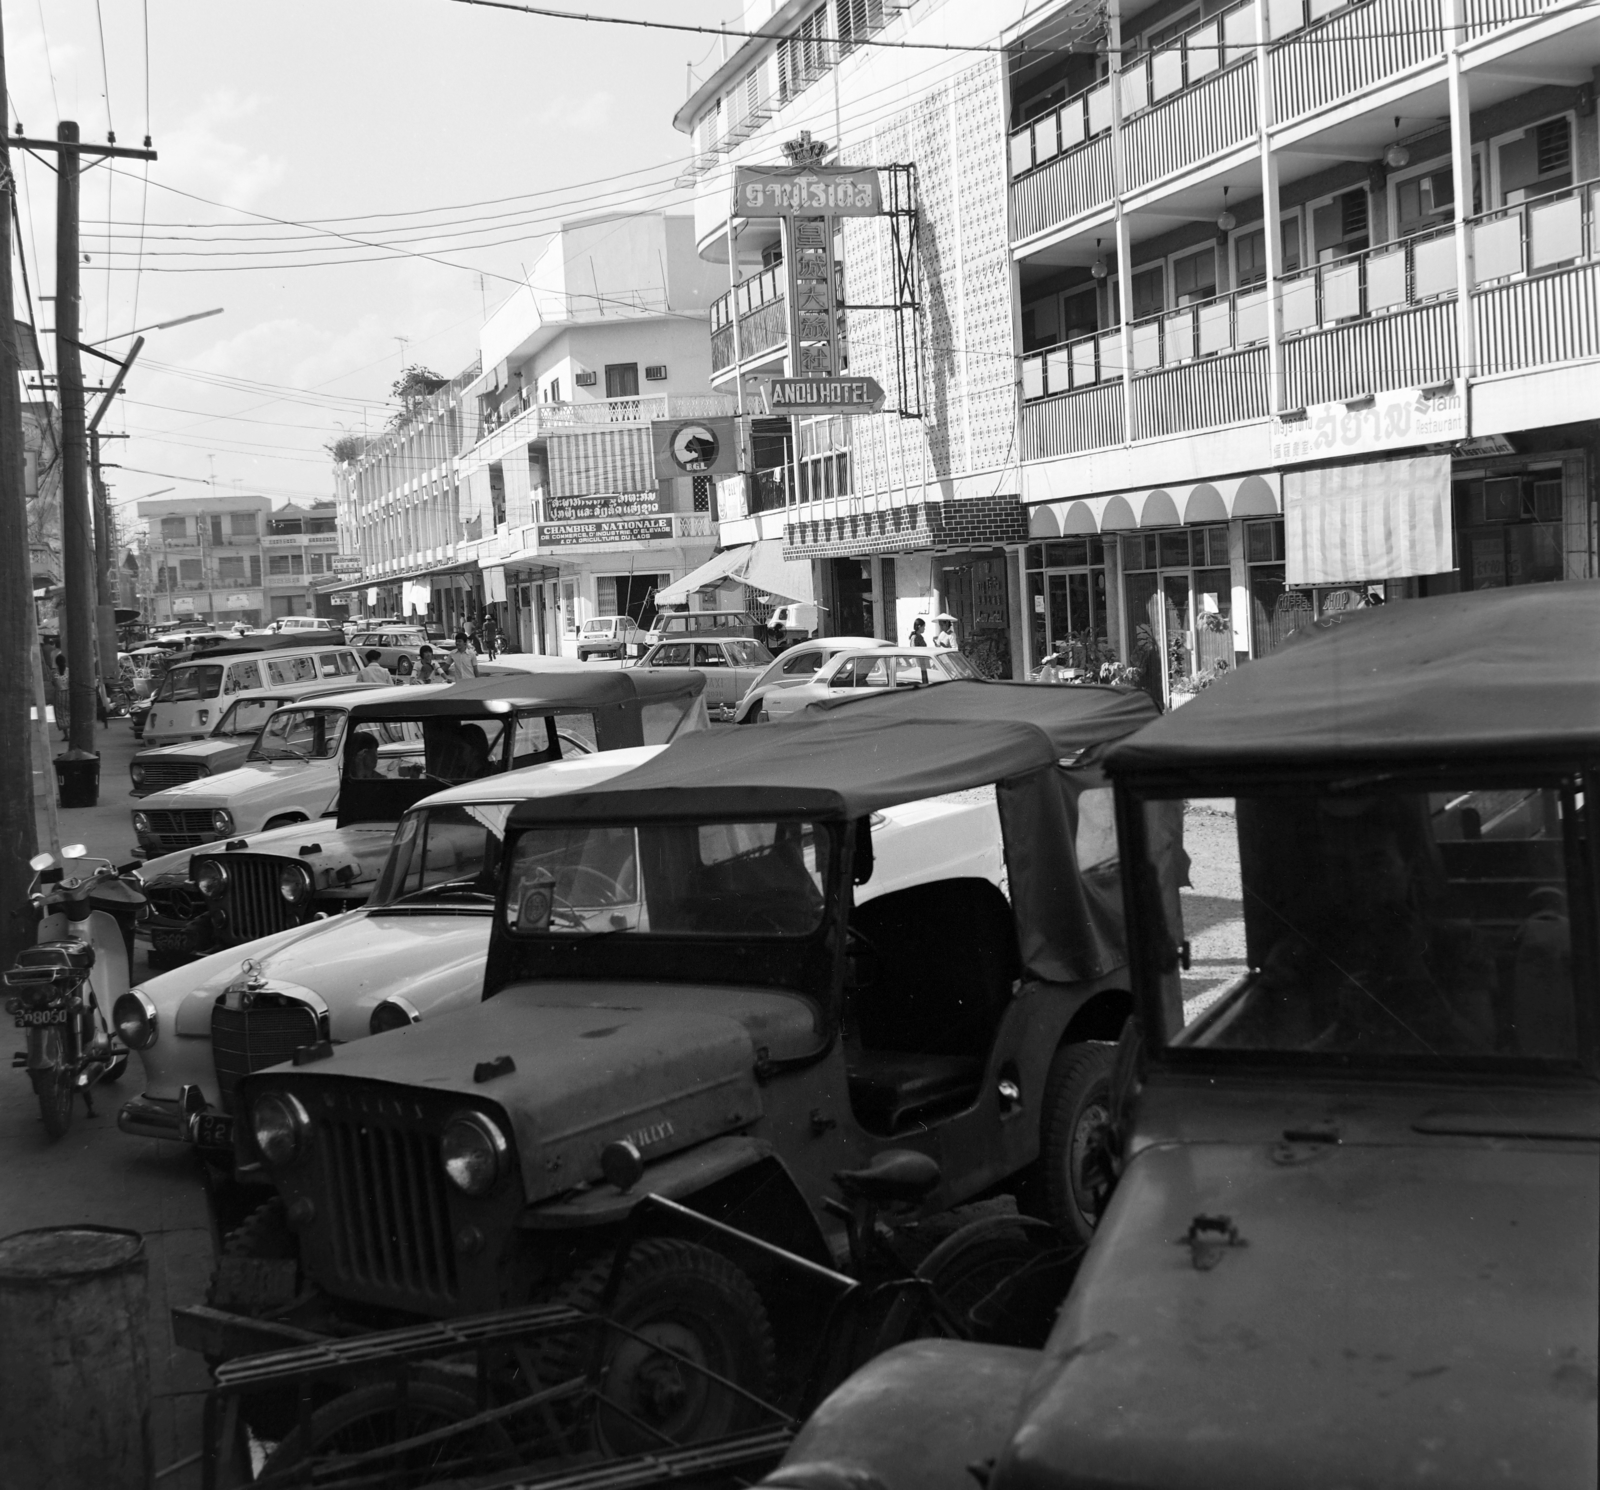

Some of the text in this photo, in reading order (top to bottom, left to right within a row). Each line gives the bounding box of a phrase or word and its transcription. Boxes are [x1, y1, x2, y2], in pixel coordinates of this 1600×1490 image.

[772, 382, 874, 404] ANOU HOTEL
[1413, 391, 1461, 416] Siam
[1415, 416, 1462, 436] Restaurant
[543, 519, 667, 535] CHAMBRE NATIONALE
[1322, 590, 1349, 611] SHOP
